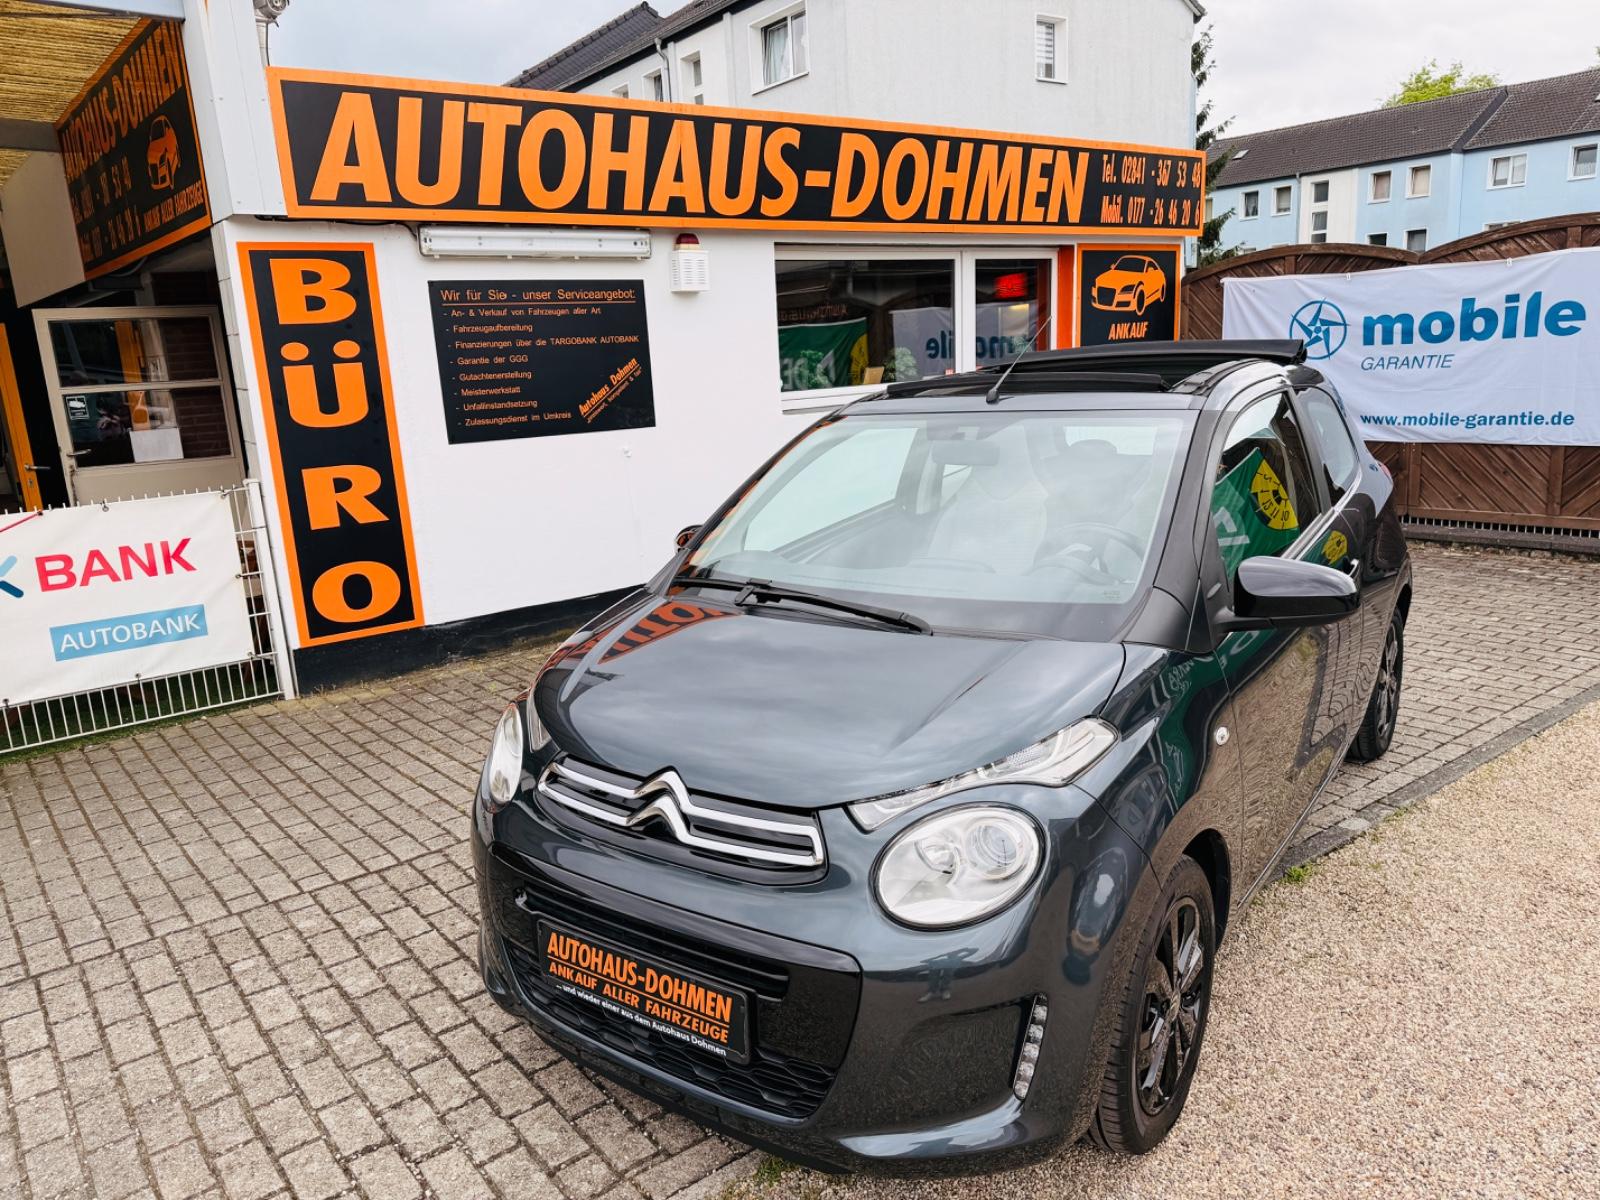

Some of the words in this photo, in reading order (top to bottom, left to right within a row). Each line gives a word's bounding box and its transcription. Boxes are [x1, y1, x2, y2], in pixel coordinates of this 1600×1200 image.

[310, 92, 1089, 224] AUTOHAUS-DOHMEN
[1102, 153, 1116, 184] Tel.
[1122, 155, 1146, 185] 02841
[1176, 160, 1187, 188] 53
[1100, 194, 1123, 224] Mobil.
[1128, 196, 1145, 224] 0177
[440, 289, 460, 301] Wir
[466, 289, 481, 300] für
[488, 289, 507, 300] Sie
[523, 290, 551, 300] unser
[469, 309, 475, 317] &
[479, 308, 507, 316] Verkauf
[528, 306, 570, 317] Fahrzeugen
[573, 307, 587, 315] aller
[591, 306, 601, 314] Art
[1362, 291, 1587, 346] mobile
[453, 323, 533, 334] Fahrzeugaufbereitung
[1108, 321, 1148, 340] ANKAUF
[455, 340, 512, 349] Finanzierungen
[516, 338, 531, 347] über
[536, 338, 547, 346] die
[550, 336, 597, 345] TARGOBANK
[600, 335, 640, 344] AUTOBANK
[457, 356, 490, 365] Garantie
[493, 355, 506, 364] der
[1360, 353, 1456, 371] GARANTIE
[459, 371, 532, 382] Gutachtenerstellung
[461, 386, 521, 396] Meisterwerkstatt
[579, 384, 610, 416] Autohaus
[609, 358, 638, 385] Dohmen
[463, 400, 538, 411] Unfallinstandsetzung
[465, 415, 528, 427] Zulassungsdienst
[543, 411, 572, 420] Umkreis
[1360, 411, 1576, 429] www.mobile-garantie.de
[269, 258, 401, 623] BÜRO
[35, 537, 197, 592] BANK
[60, 613, 200, 652] AUTOBANK
[547, 932, 733, 1023] AUTOHAUS-DOHMEN
[549, 961, 598, 990] ANKAUF
[602, 983, 640, 1009] ALLER
[645, 1000, 729, 1044] FAHRZEUGE
[562, 985, 577, 996] und
[577, 988, 601, 1006] wieder
[601, 1000, 620, 1013] einer
[621, 1008, 634, 1020] aus
[634, 1014, 651, 1028] dem
[652, 1021, 690, 1042] Autohaus
[690, 1034, 727, 1057] Dohmen
